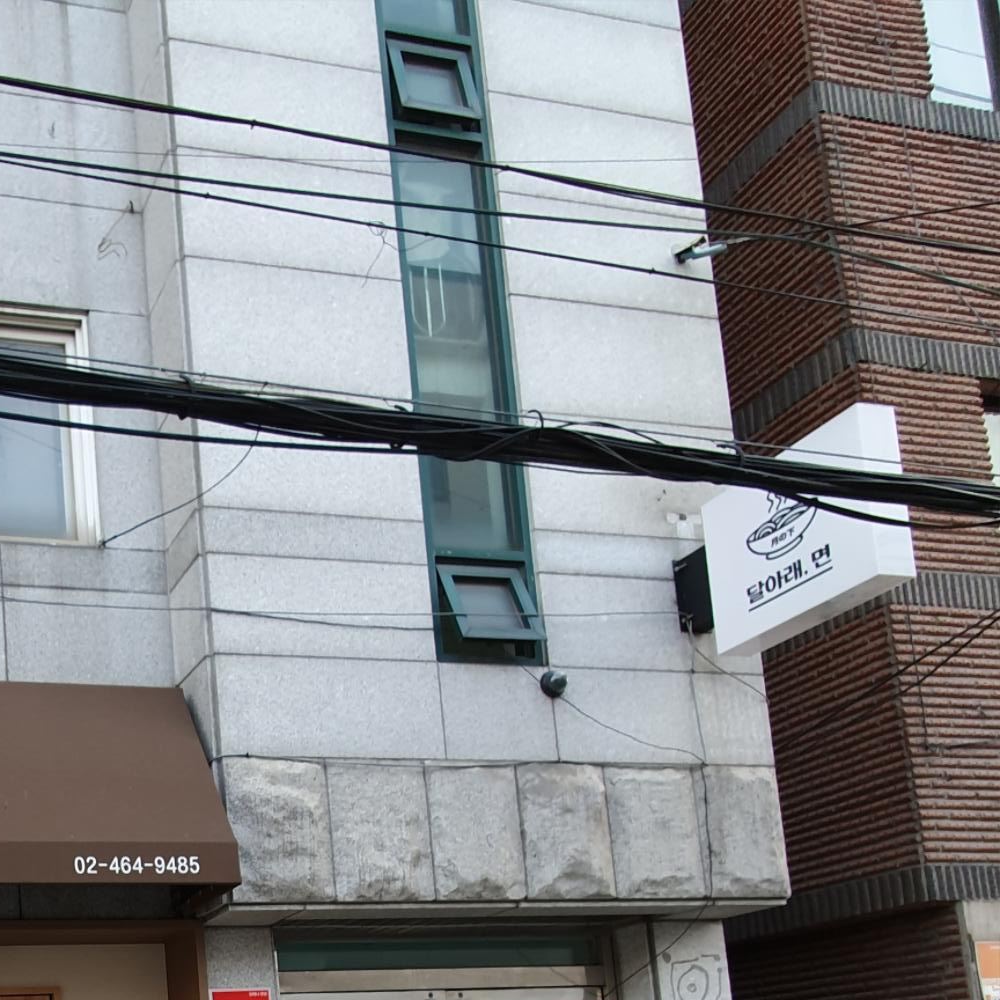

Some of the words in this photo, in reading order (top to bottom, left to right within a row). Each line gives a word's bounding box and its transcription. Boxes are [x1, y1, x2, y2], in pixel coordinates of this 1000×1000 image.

[771, 526, 795, 548] 月の下
[811, 544, 832, 569] 면
[74, 856, 200, 874] 02-464-9485
